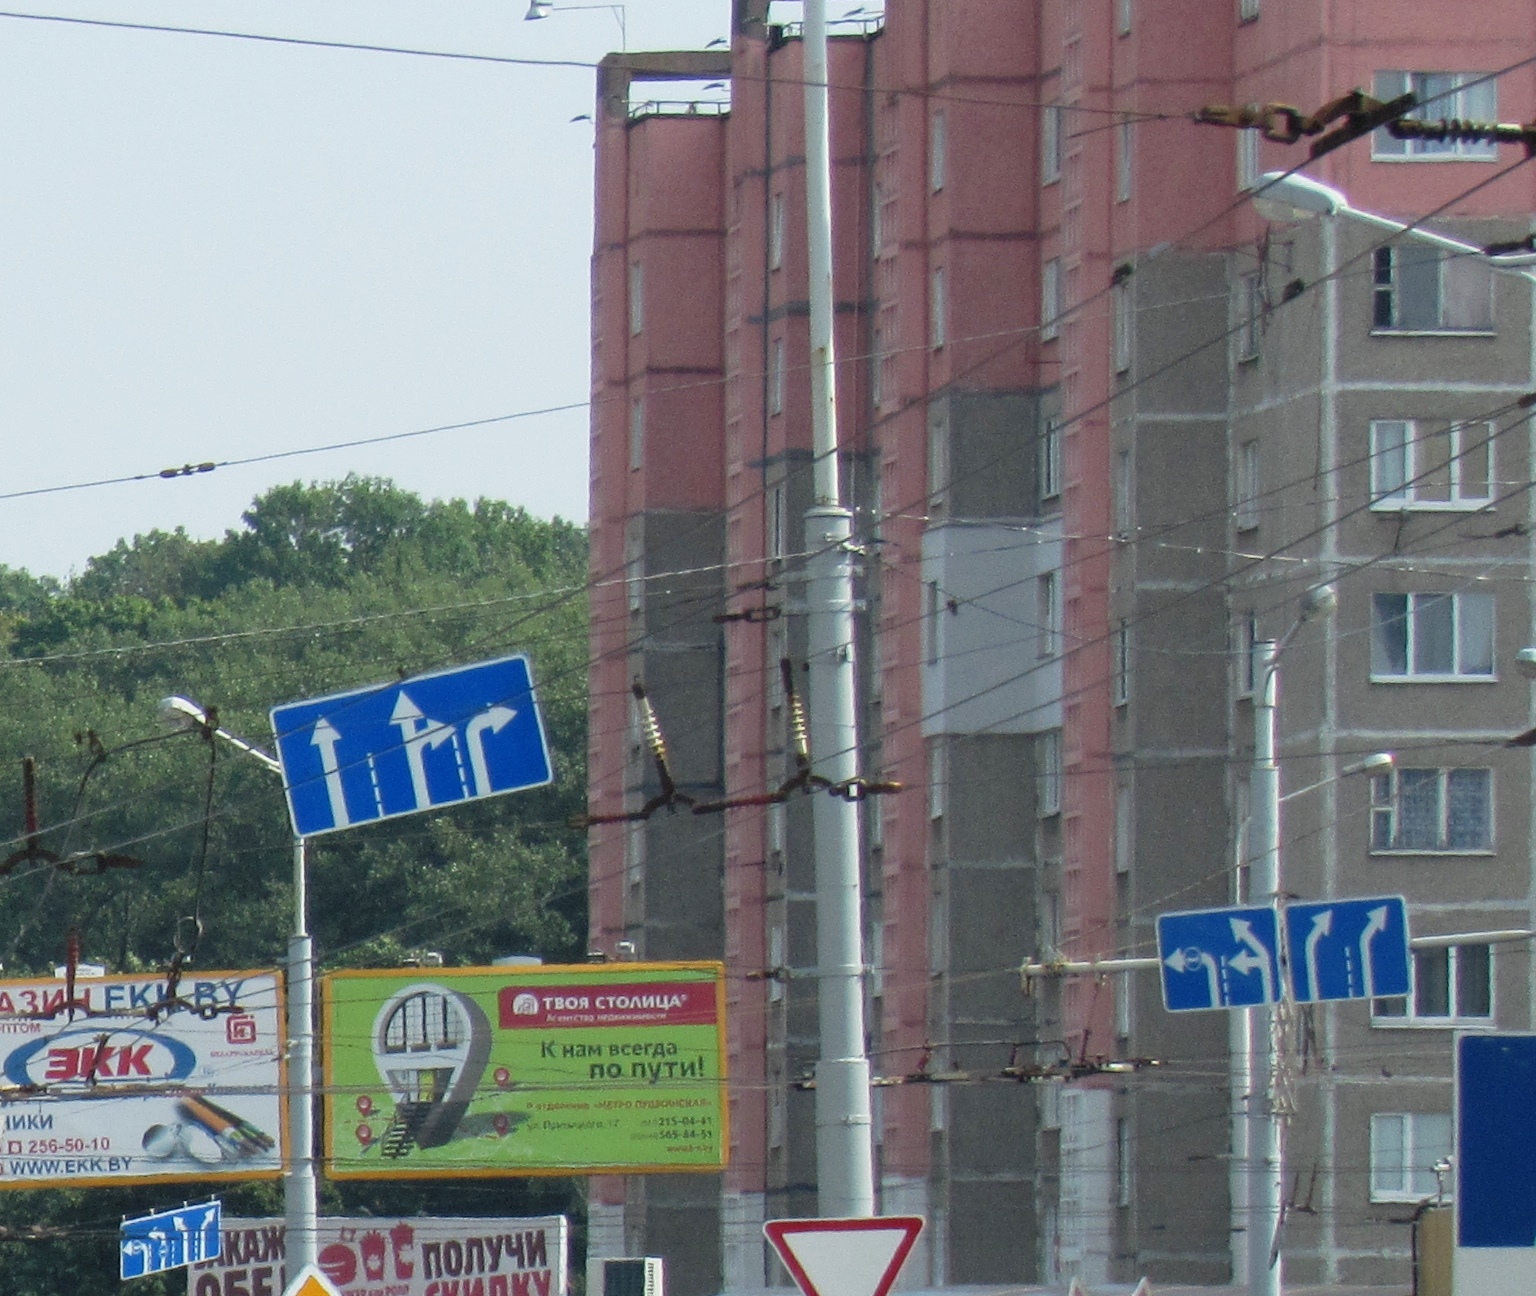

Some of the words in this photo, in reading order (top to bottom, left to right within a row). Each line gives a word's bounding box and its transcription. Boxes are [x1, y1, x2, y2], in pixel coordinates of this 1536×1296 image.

[541, 995, 590, 1011] ТВОЯ
[541, 1040, 557, 1059] К
[562, 1044, 603, 1058] нам
[608, 1041, 678, 1059] всегда
[44, 1043, 155, 1080] ЭКК
[589, 1062, 623, 1080] по
[631, 1054, 705, 1086] пути!
[28, 1136, 111, 1155] 256-50-10
[9, 1156, 134, 1176] WWW.EKK.BY
[421, 1229, 548, 1279] ПОЛУЧИ
